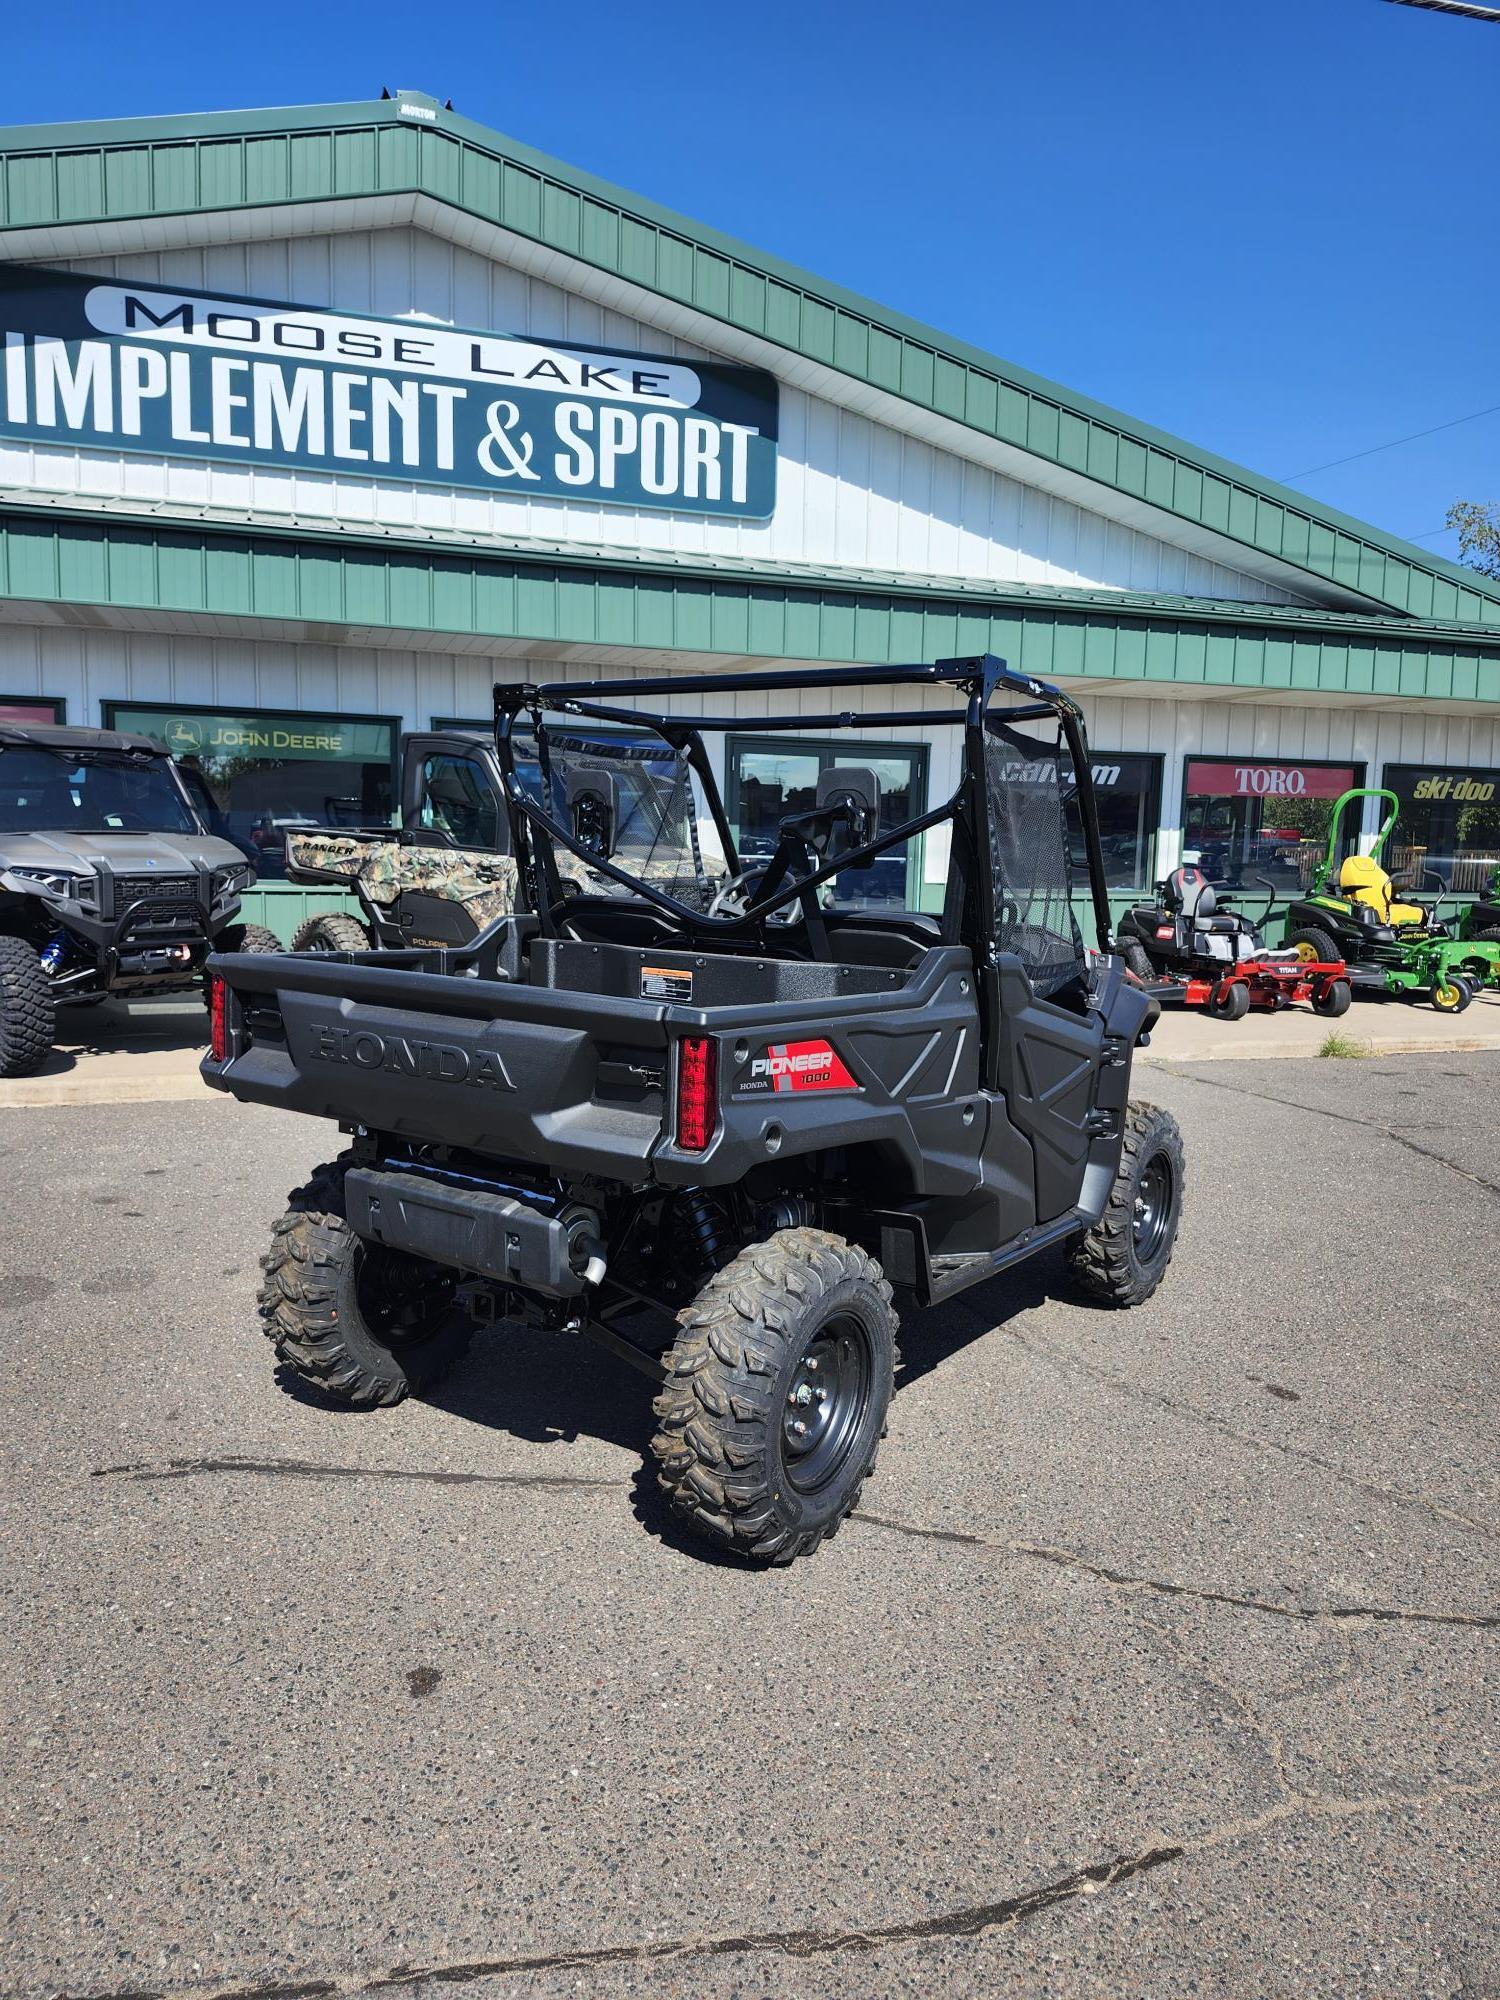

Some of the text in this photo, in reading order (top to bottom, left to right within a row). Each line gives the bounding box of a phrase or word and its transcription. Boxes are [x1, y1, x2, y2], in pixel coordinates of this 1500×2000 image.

[401, 104, 436, 120] MORTON
[125, 296, 670, 398] MOOSE LAKE
[6, 331, 759, 503] IMPLEMENT & SPORT
[210, 729, 342, 750] JOHN DEERE
[303, 842, 355, 855] RANGER
[122, 886, 192, 897] POLARIS
[412, 938, 449, 949] POLARIS
[1279, 966, 1298, 974] TITAN
[309, 1023, 518, 1093] HONDA
[751, 1051, 833, 1077] PIONEER
[802, 1072, 831, 1084] 1000
[739, 1081, 768, 1090] HONDA
